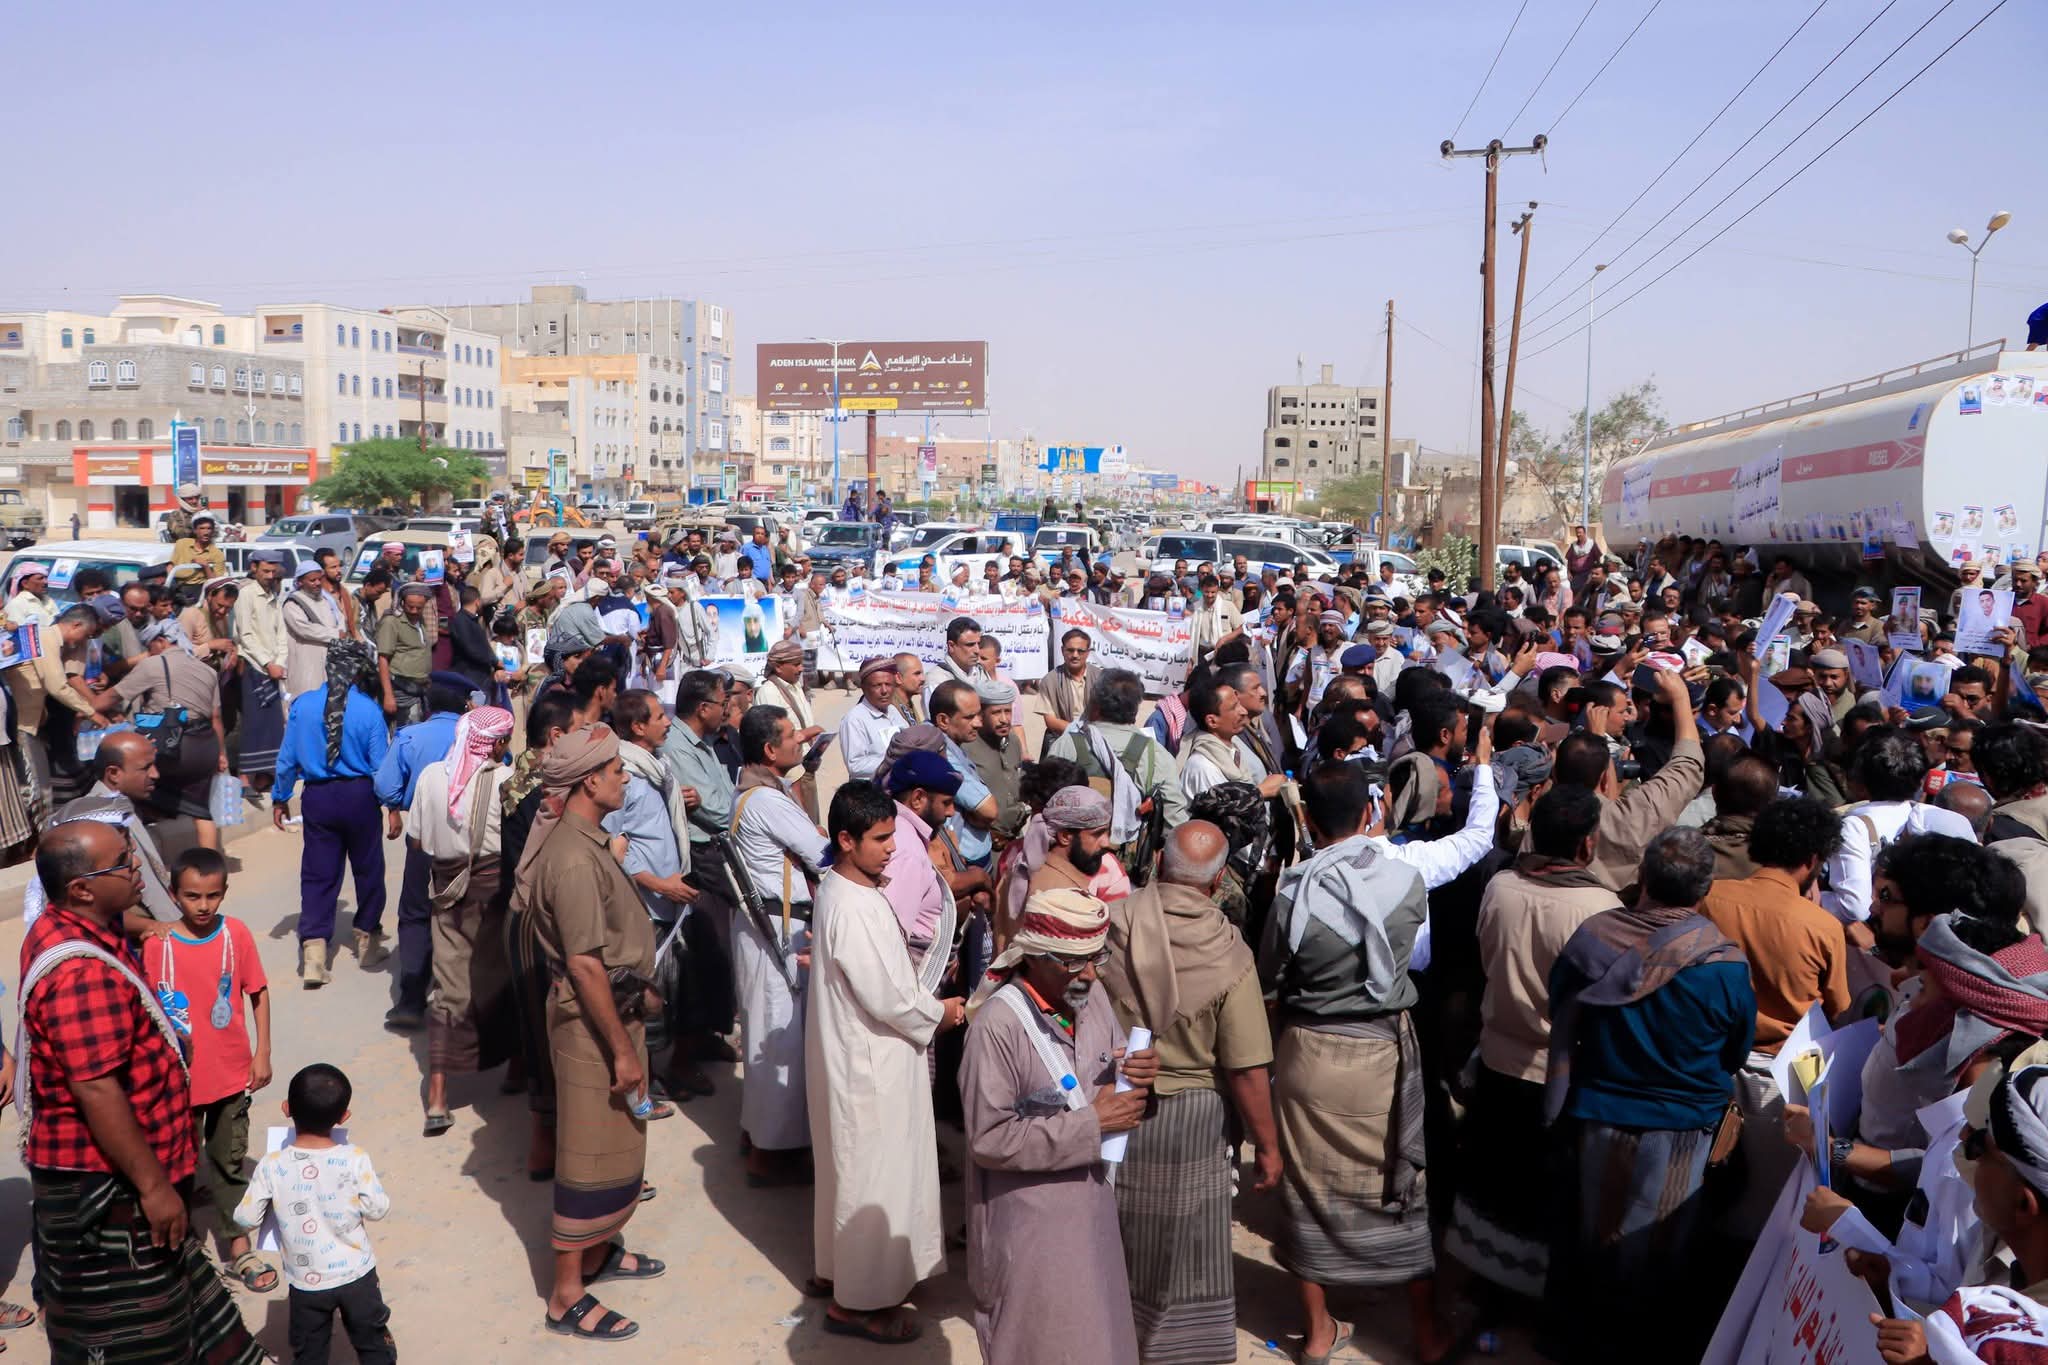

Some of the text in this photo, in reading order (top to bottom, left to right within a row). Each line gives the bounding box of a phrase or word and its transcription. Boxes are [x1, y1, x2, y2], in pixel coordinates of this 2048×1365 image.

[770, 358, 856, 367] ADEN ISLAMIC BANK
[885, 353, 972, 368] بنك عدن الإسلامي
[1062, 607, 1099, 628] المحكمة
[1101, 616, 1122, 633] حكم
[1126, 618, 1164, 642] بتنفيذ
[1159, 651, 1188, 665] مبارك
